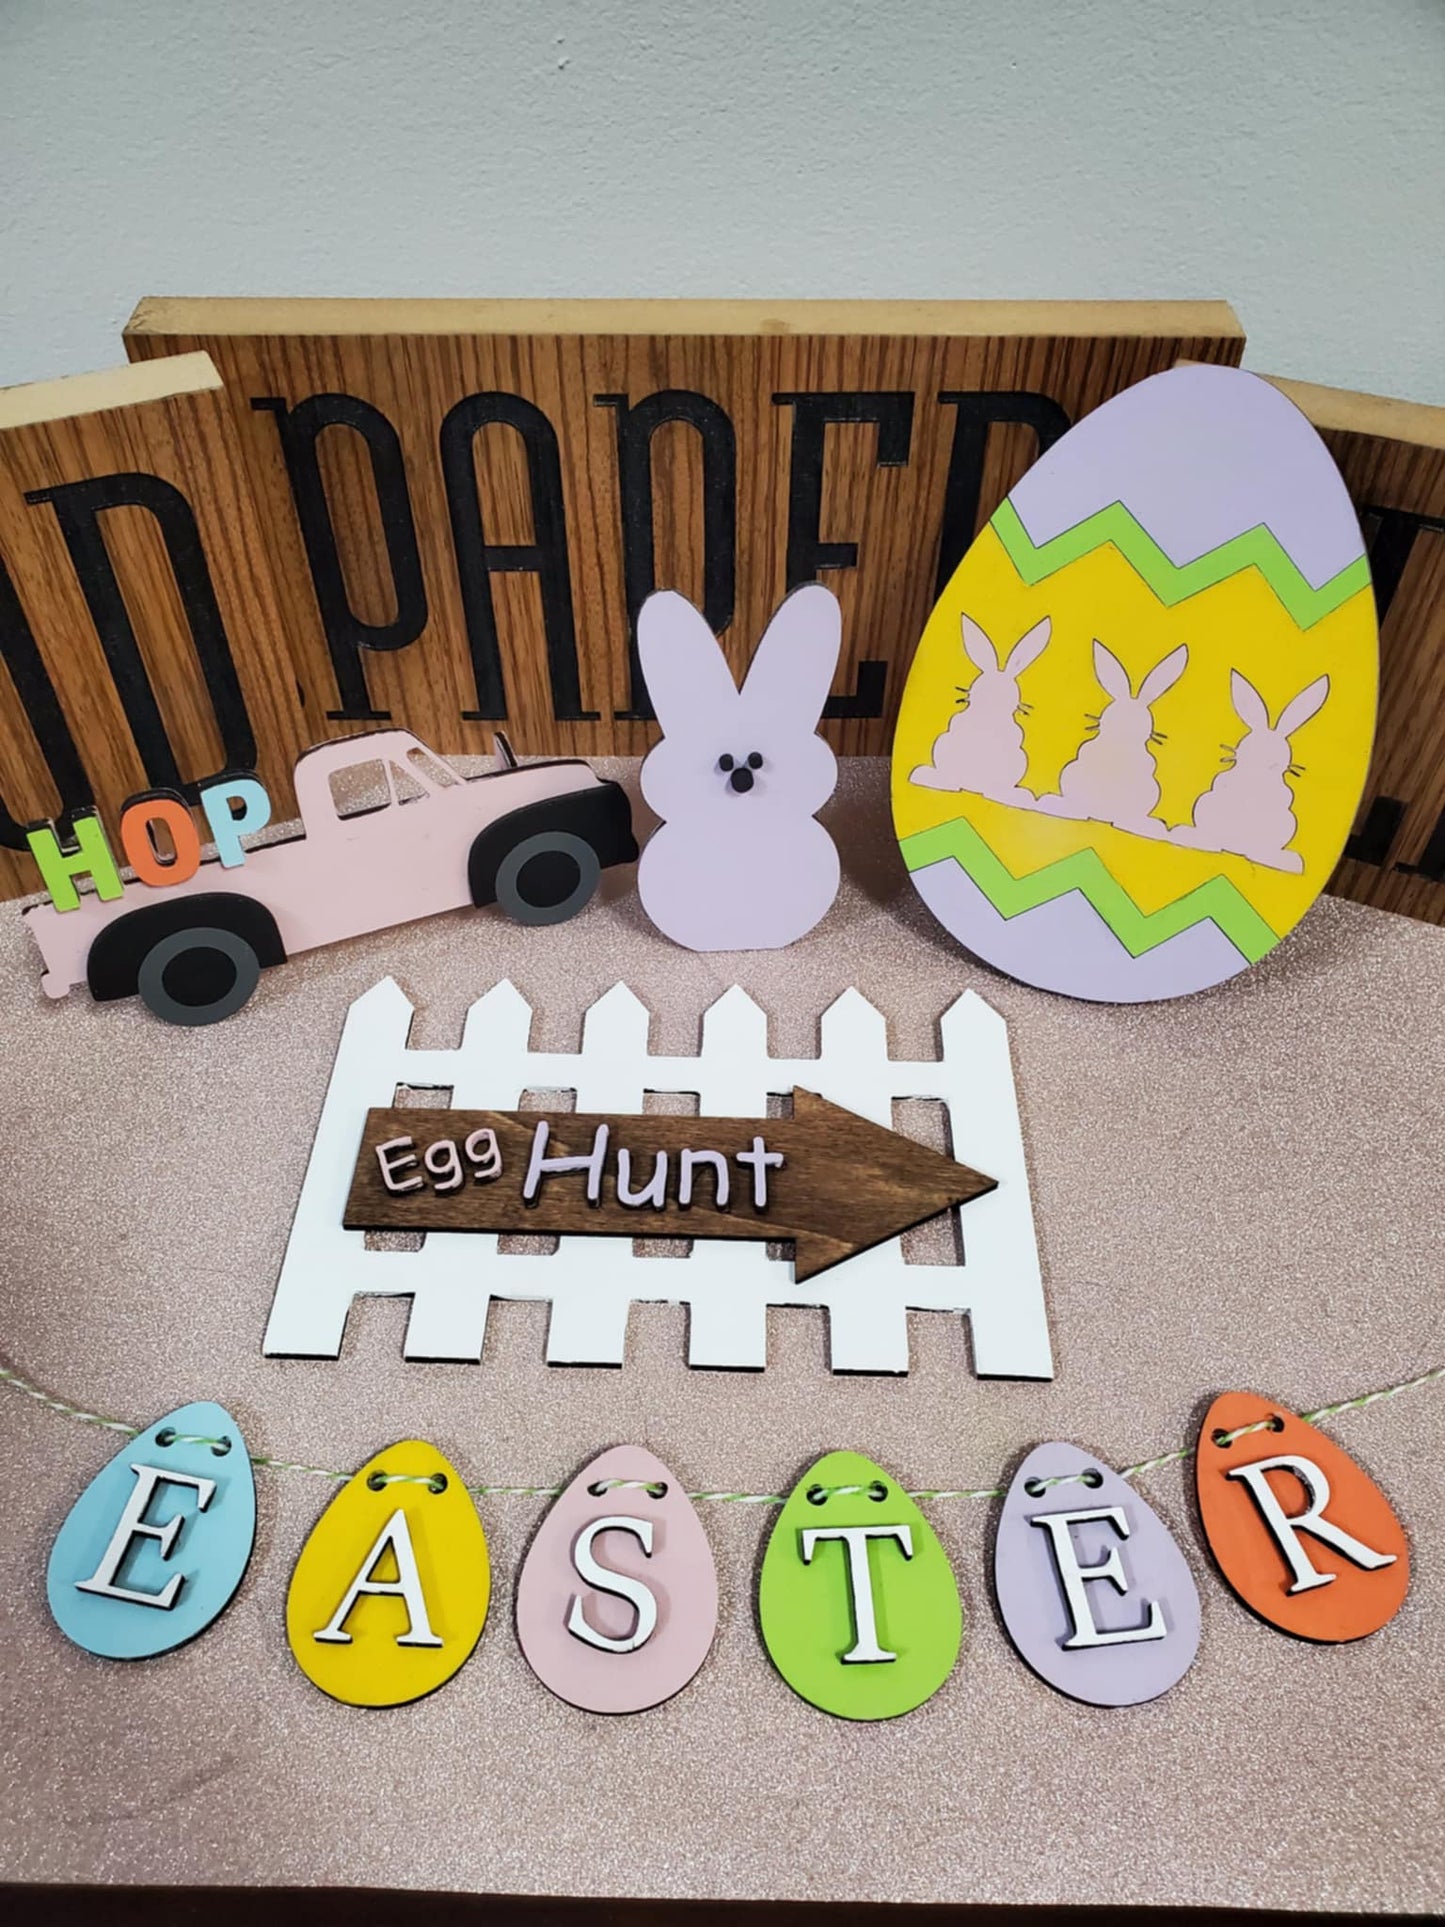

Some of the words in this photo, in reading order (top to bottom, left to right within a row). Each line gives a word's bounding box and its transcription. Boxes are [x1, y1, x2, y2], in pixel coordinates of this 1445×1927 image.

[26, 777, 271, 913] HOP
[375, 1127, 502, 1193] Egg
[522, 1120, 784, 1212] Hunt
[75, 1454, 1397, 1665] EASTER
